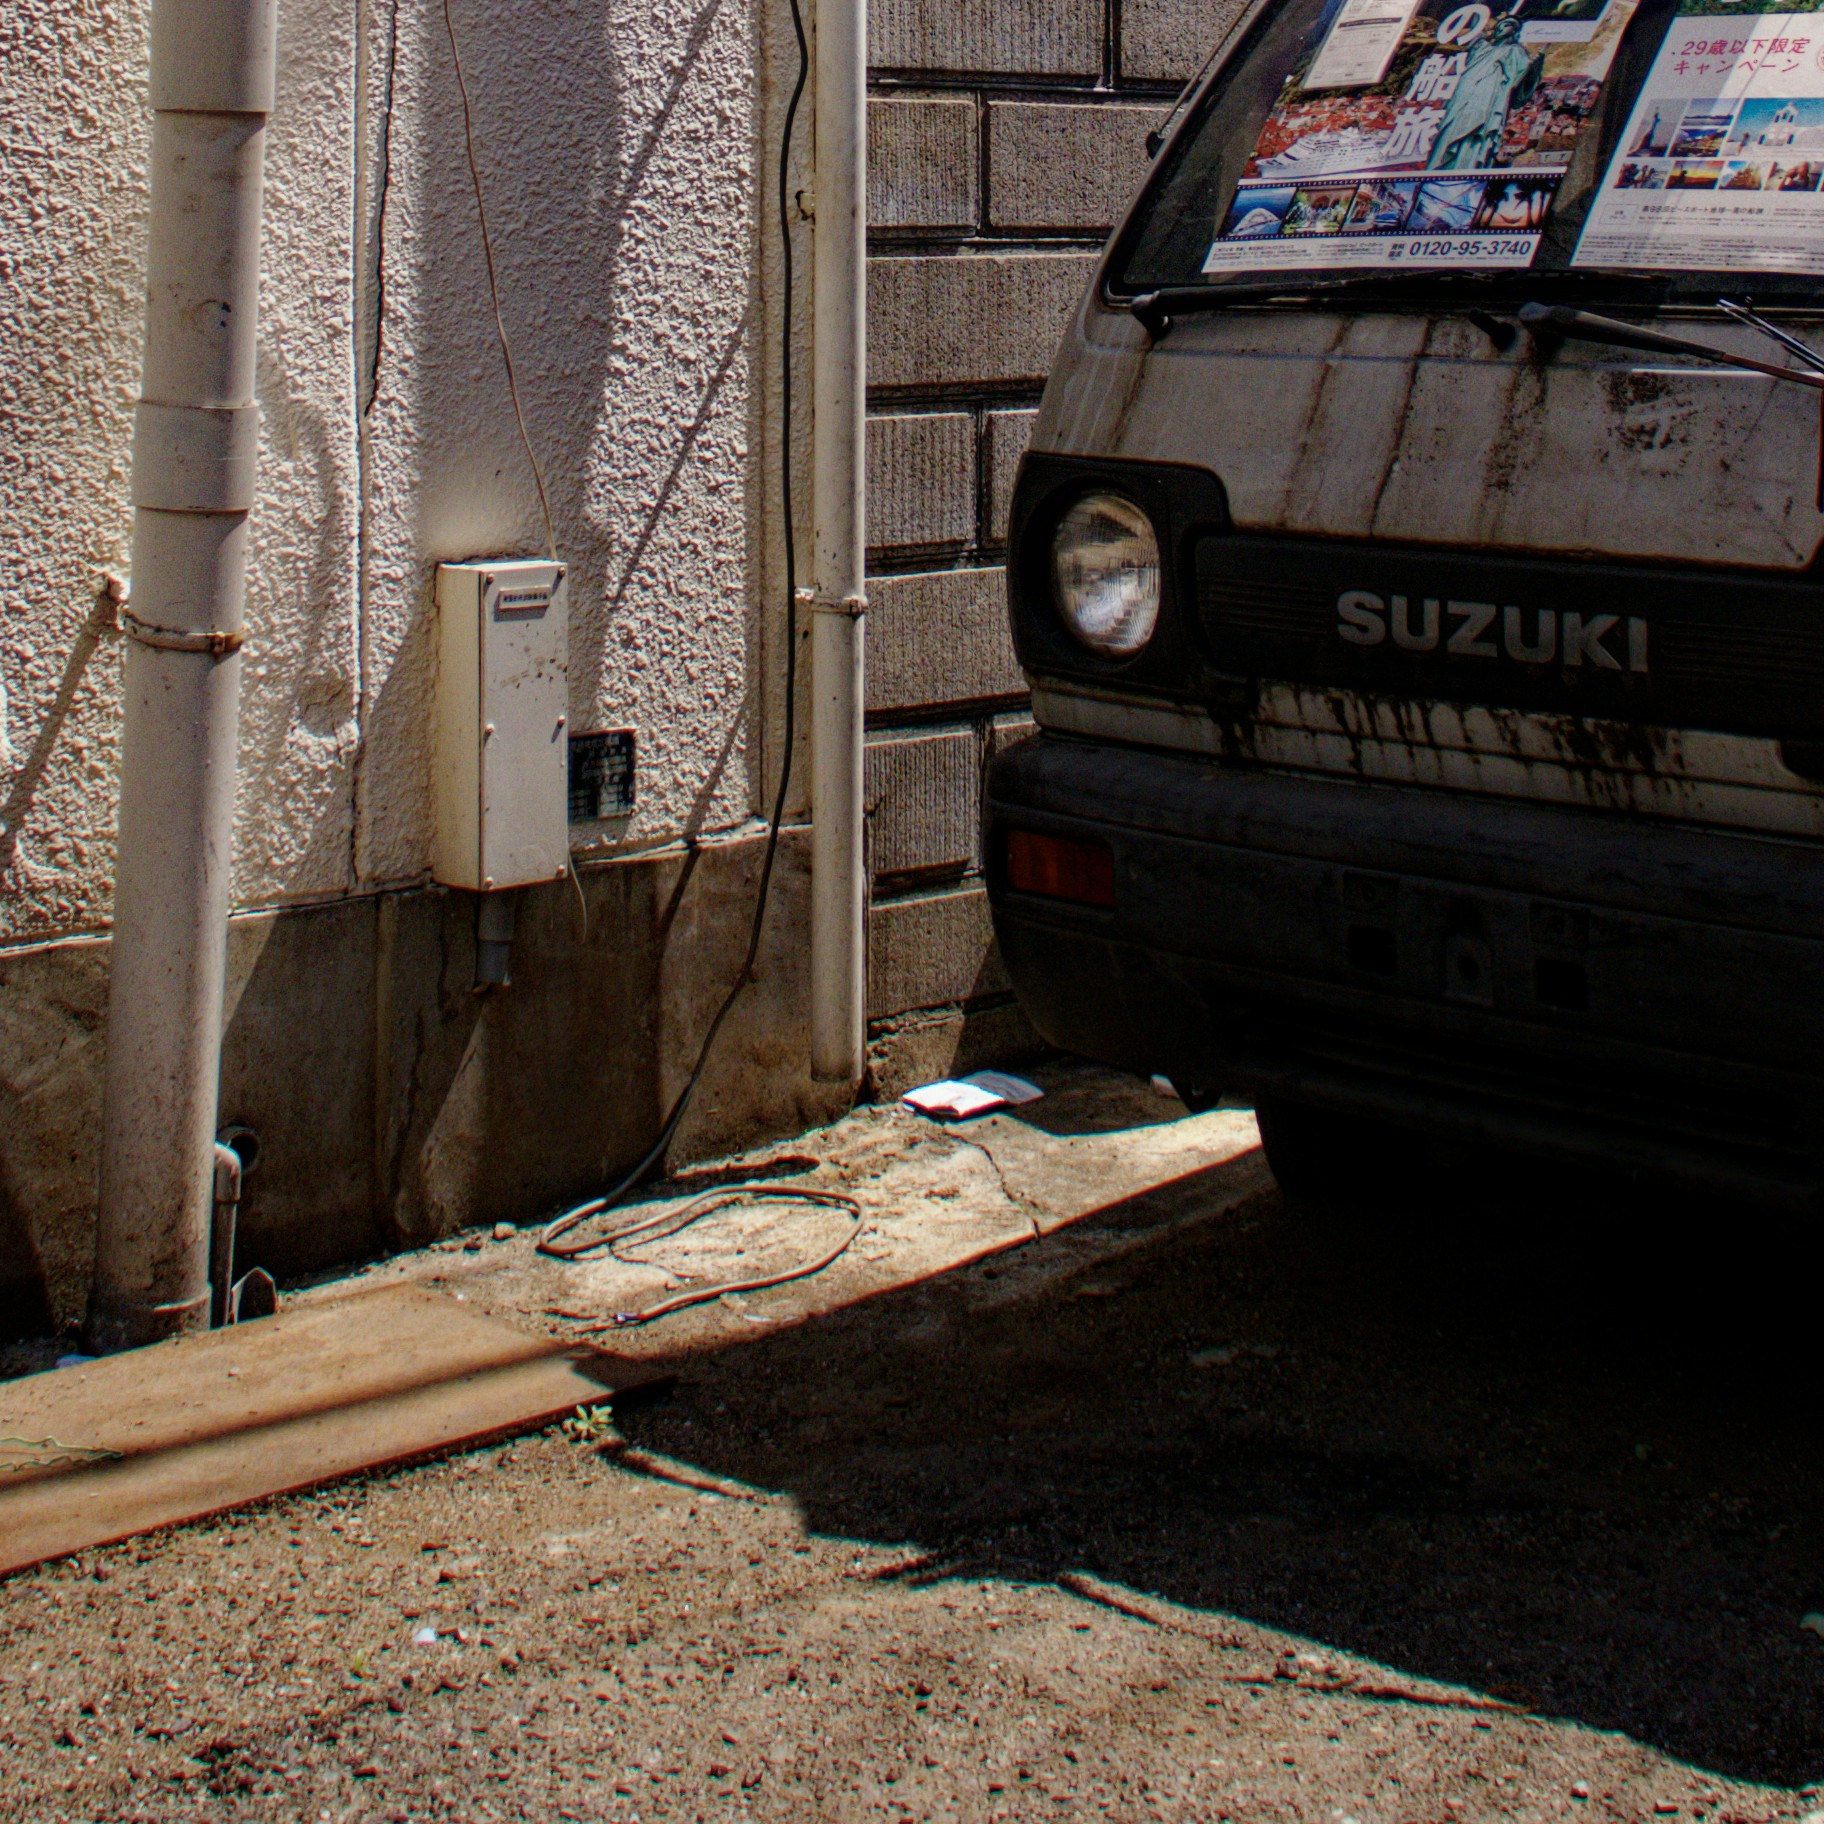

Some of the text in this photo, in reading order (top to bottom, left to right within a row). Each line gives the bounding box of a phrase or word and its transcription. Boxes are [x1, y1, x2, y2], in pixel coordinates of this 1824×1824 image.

[1680, 37, 1811, 55] 29歳以下限定
[1673, 58, 1800, 75] キャンペーン
[1408, 238, 1532, 257] 0120-95-3740
[1335, 587, 1650, 674] SUZUKI
